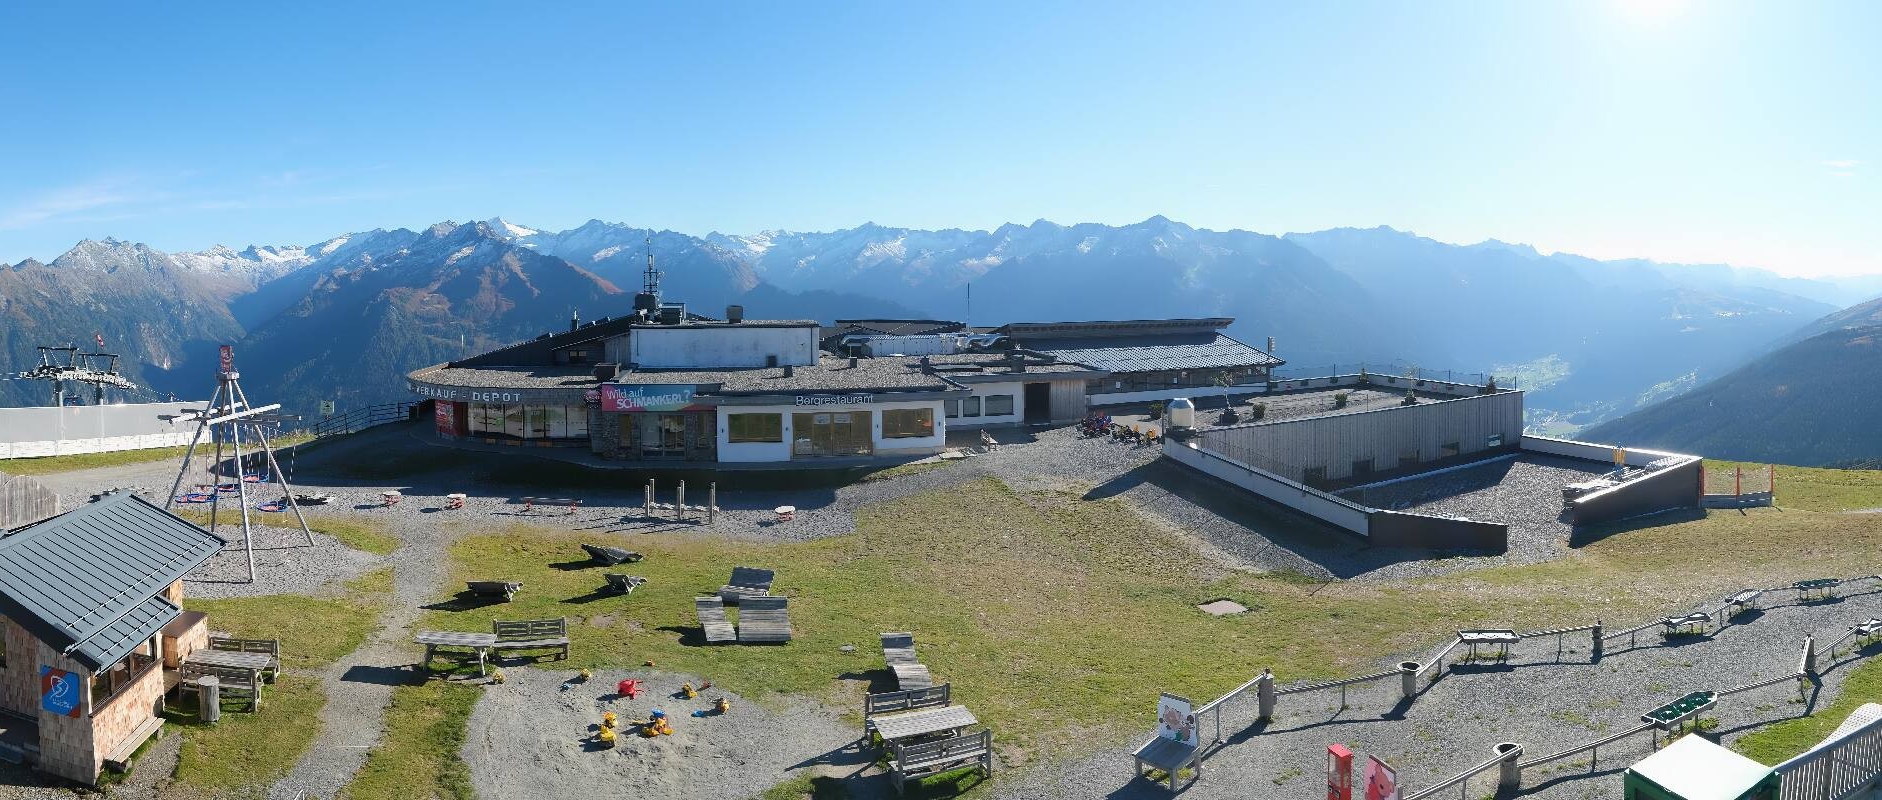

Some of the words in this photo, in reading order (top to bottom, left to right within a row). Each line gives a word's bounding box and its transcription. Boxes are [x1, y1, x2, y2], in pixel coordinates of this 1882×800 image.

[473, 392, 521, 402] DEPOT
[606, 388, 627, 400] Wild
[629, 386, 644, 398] auf
[795, 394, 874, 406] Bergrestaurant
